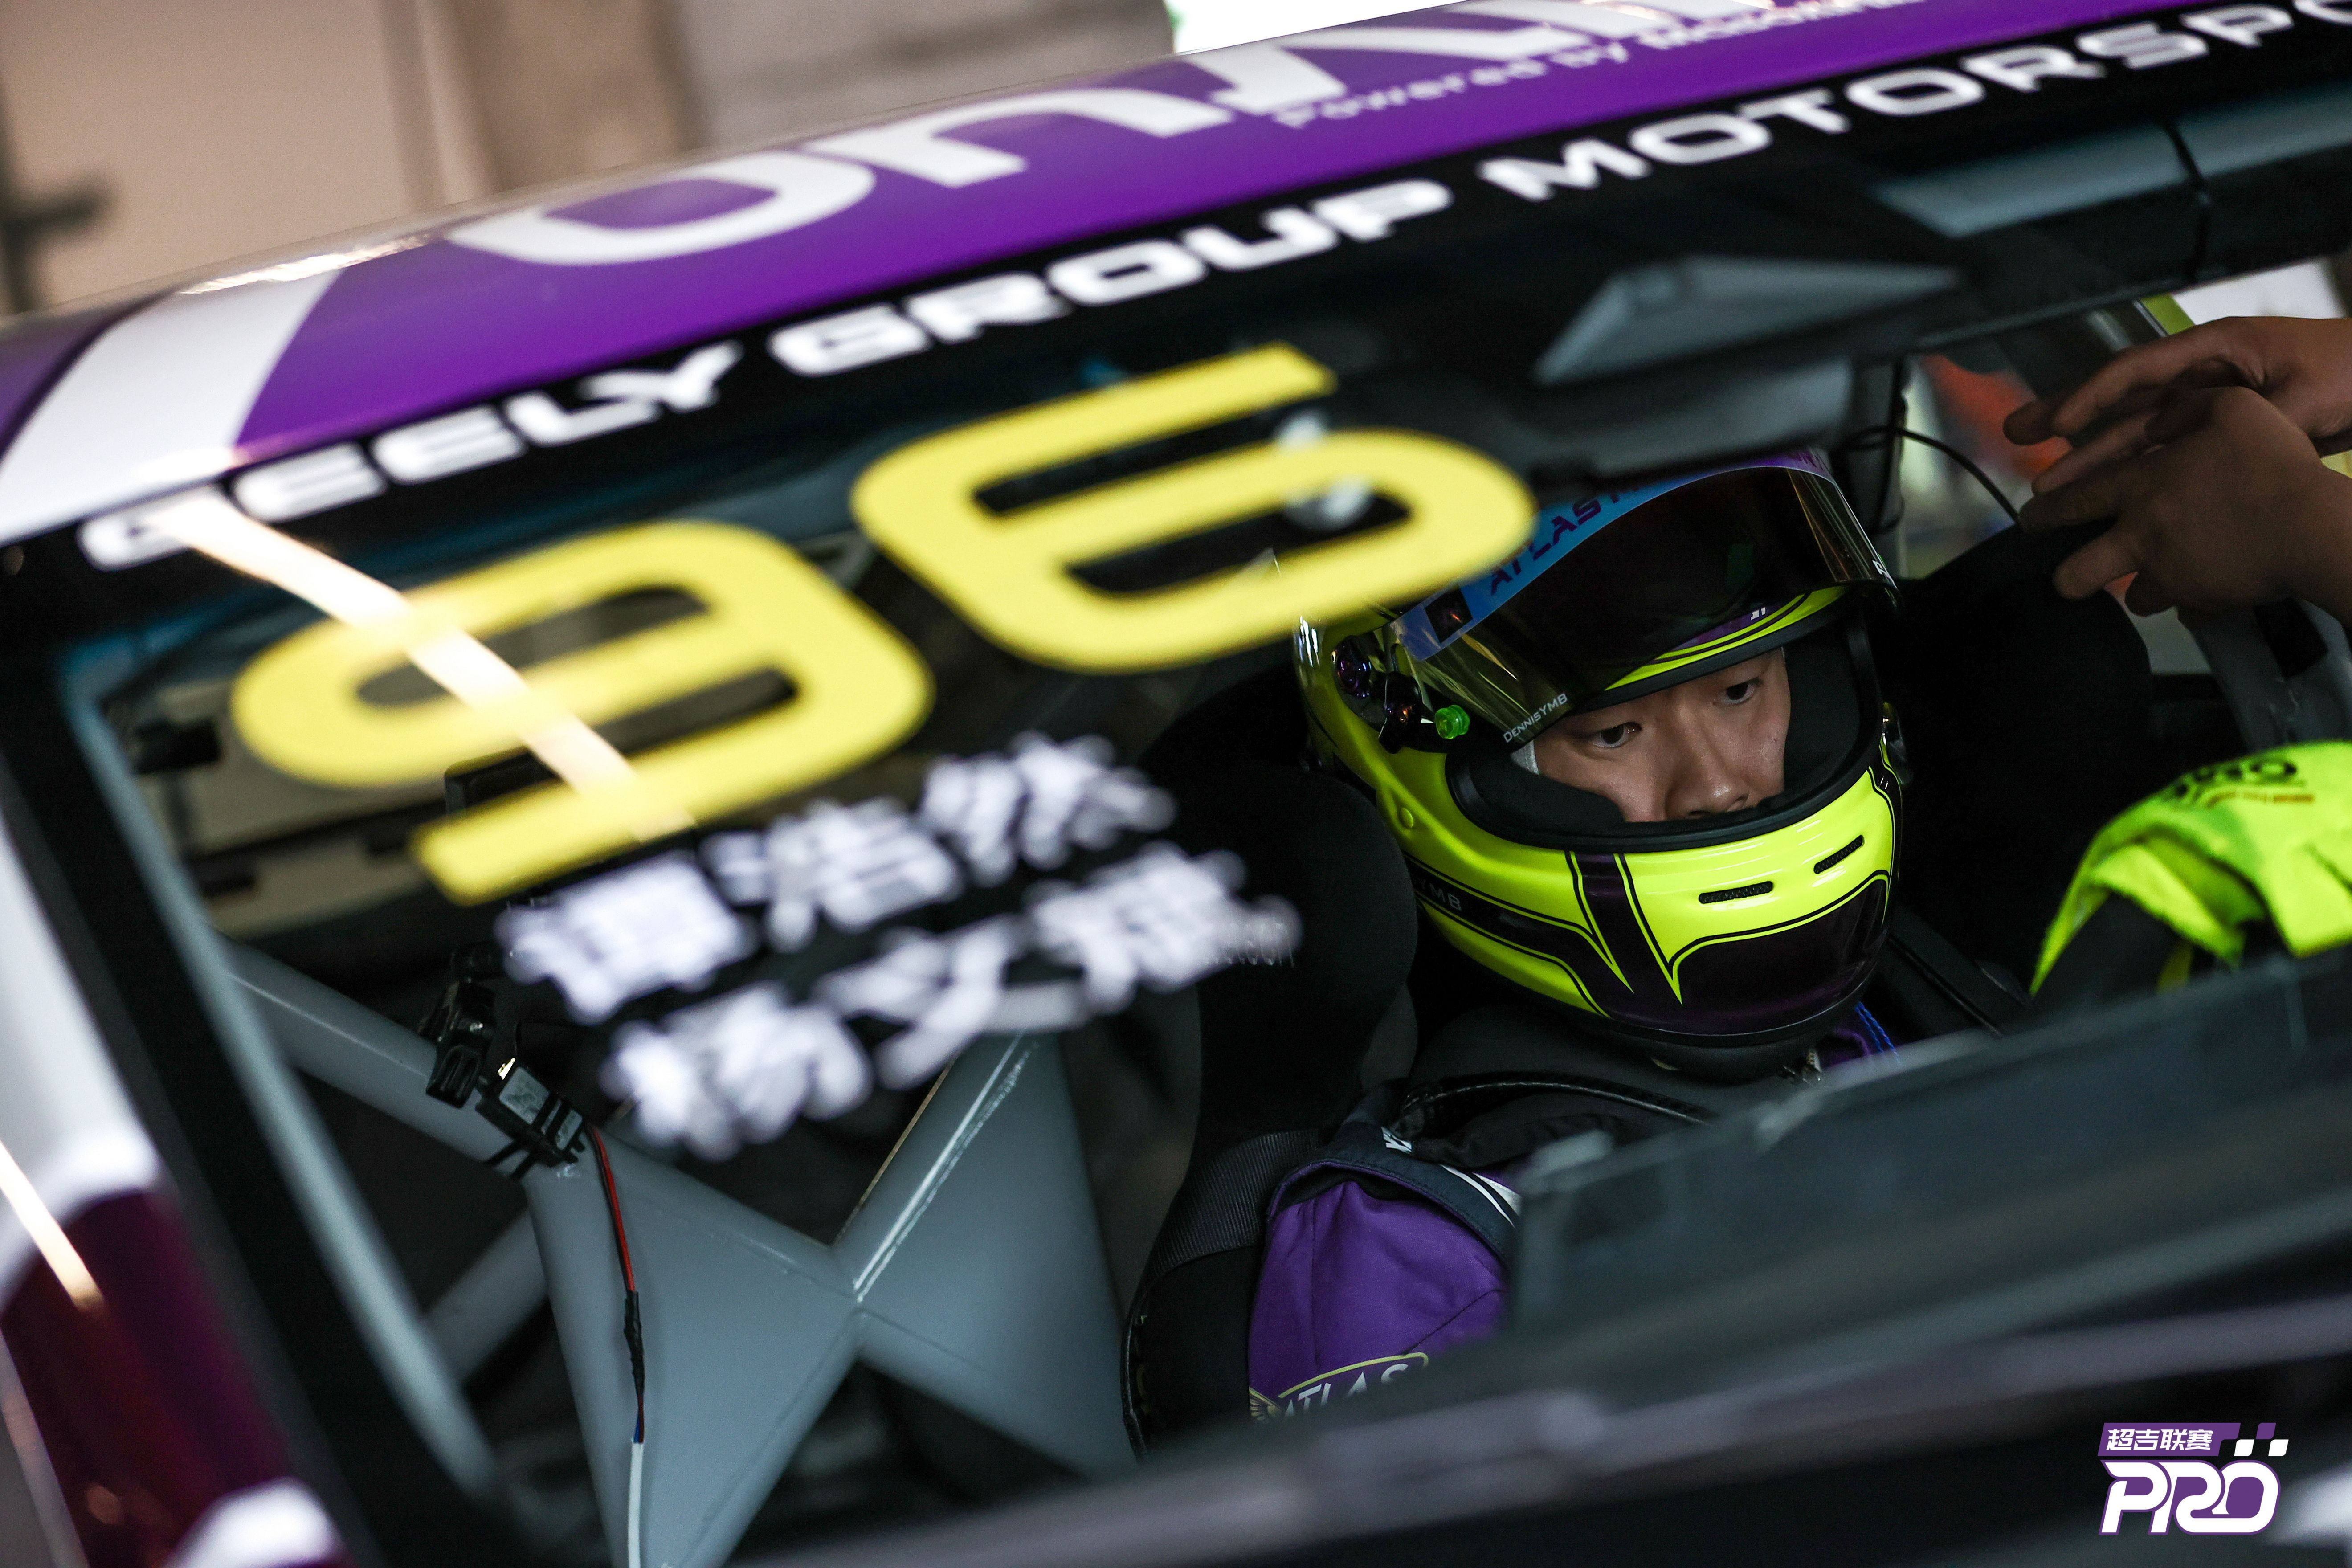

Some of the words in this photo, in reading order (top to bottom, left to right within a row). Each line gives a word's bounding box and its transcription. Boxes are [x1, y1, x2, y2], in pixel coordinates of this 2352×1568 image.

[76, 343, 739, 572] GEELY
[768, 180, 1452, 378] GROUP
[229, 345, 1535, 899] 96
